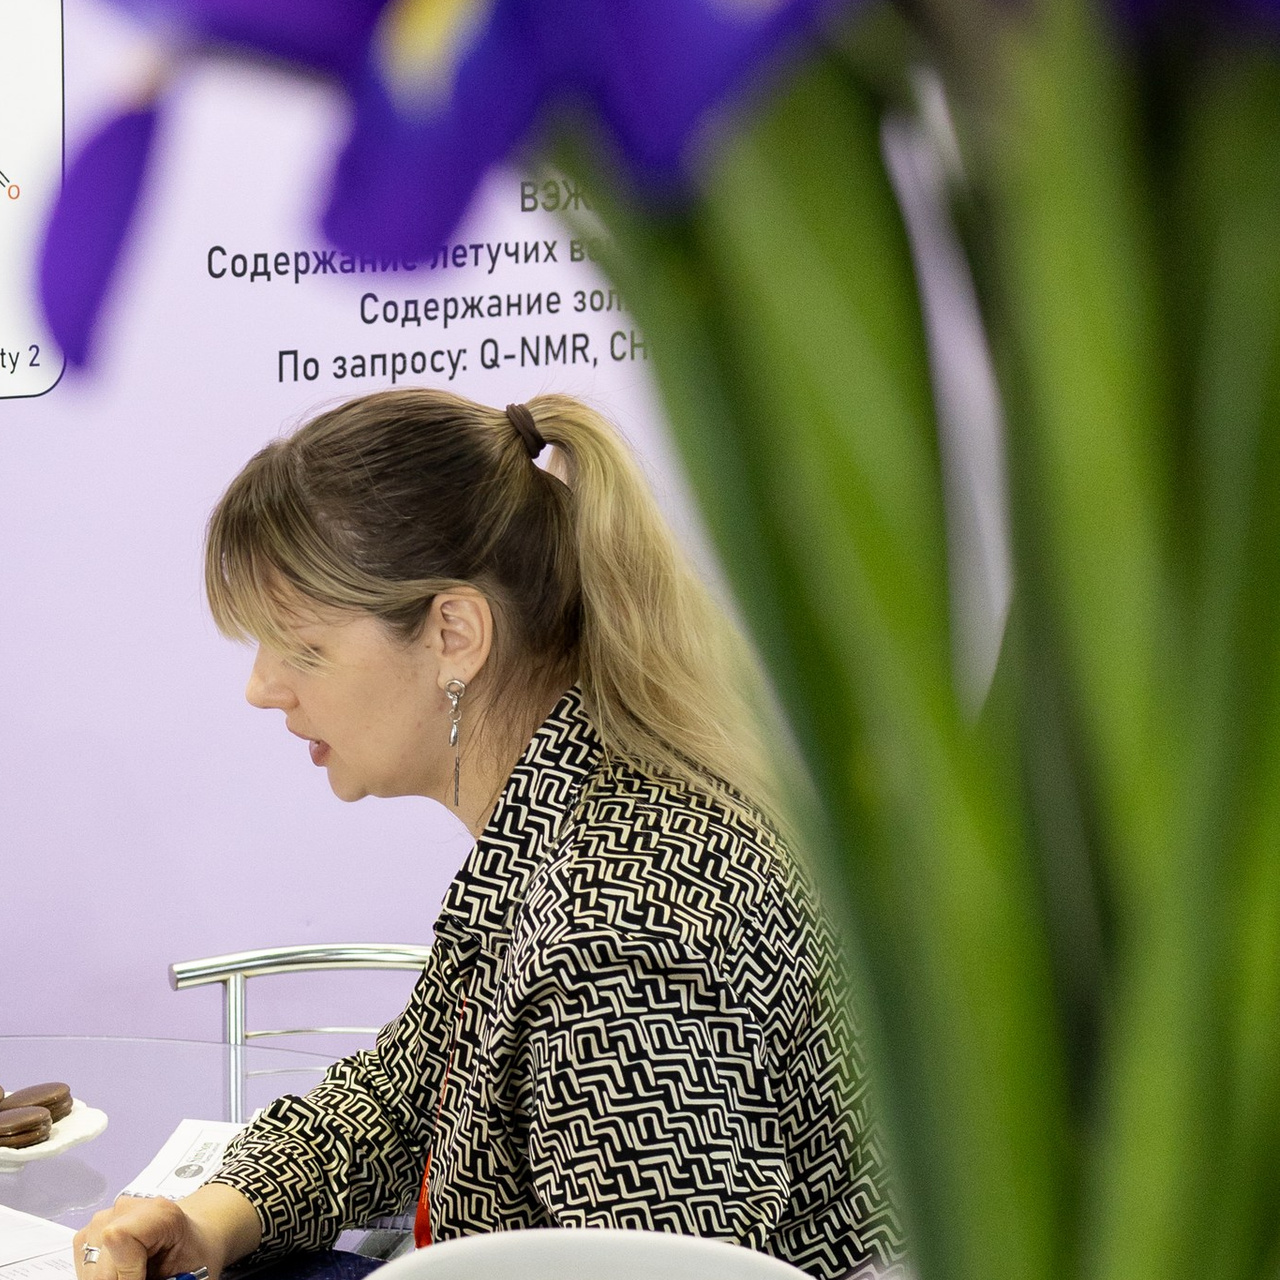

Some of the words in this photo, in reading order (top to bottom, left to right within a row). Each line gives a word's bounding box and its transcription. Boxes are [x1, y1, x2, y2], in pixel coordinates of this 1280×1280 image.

[8, 184, 20, 200] O
[520, 179, 593, 213] ВЭЖ
[361, 292, 560, 328] Содержание
[573, 289, 623, 313] зол
[29, 345, 40, 366] 2
[279, 350, 319, 382] По
[333, 349, 466, 384] запросу:
[481, 333, 597, 369] Q-NMR,
[610, 330, 648, 362] CH
